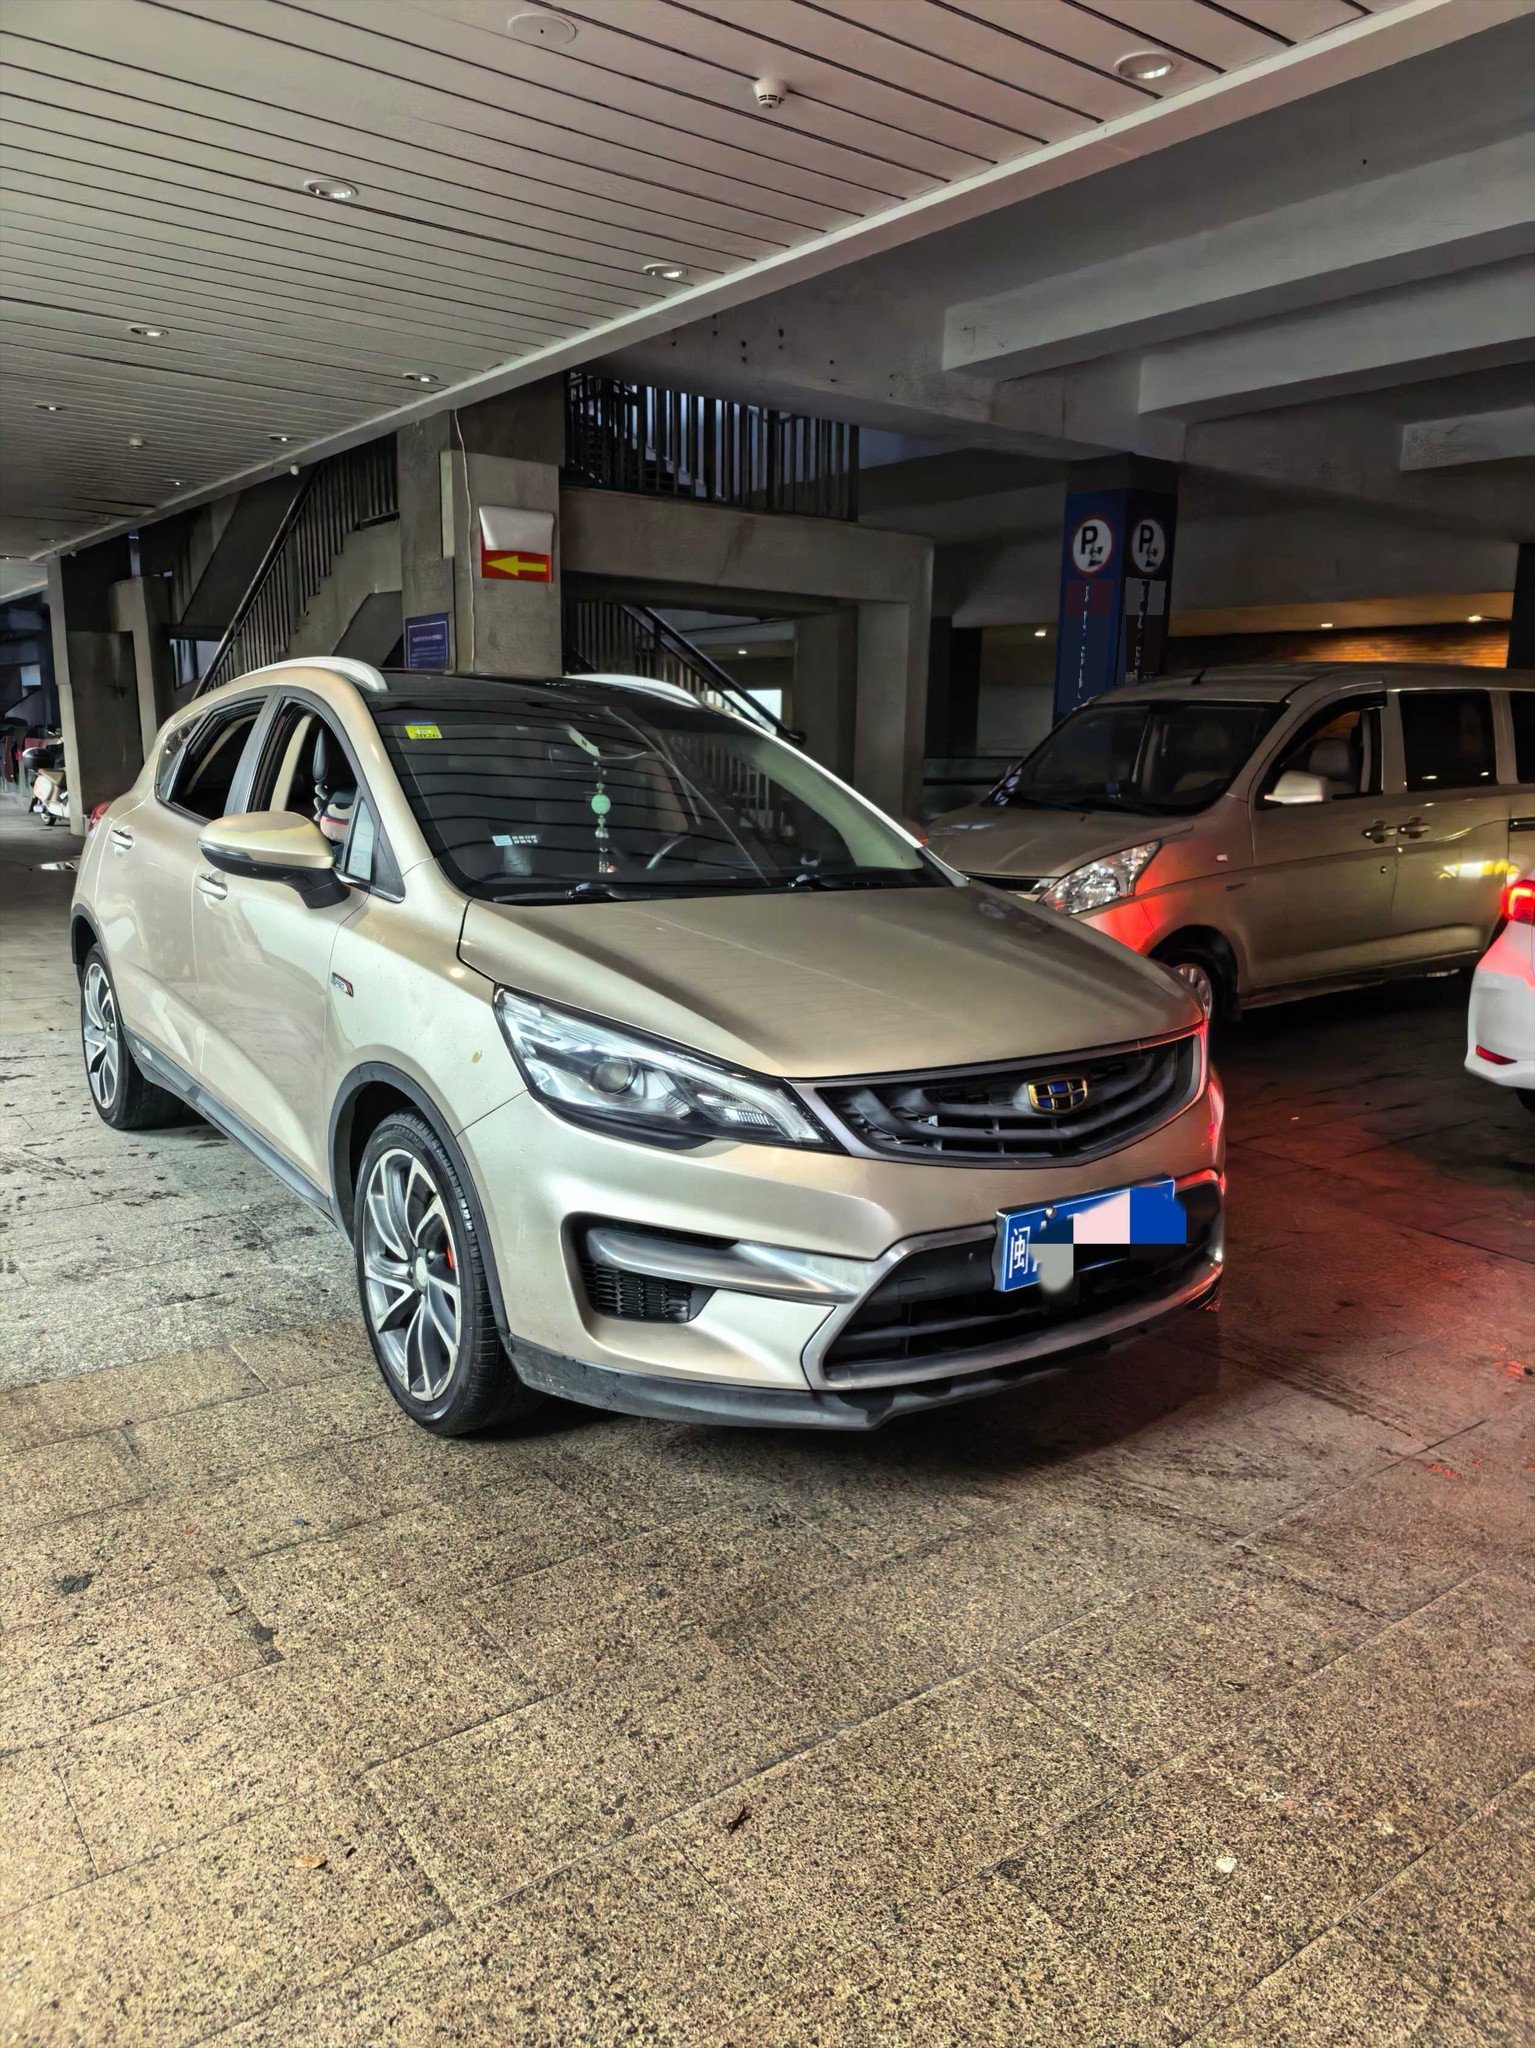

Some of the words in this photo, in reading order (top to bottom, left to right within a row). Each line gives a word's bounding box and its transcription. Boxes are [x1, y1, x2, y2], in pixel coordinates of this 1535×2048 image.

[1081, 525, 1098, 555] P
[1138, 524, 1154, 553] P
[1008, 1225, 1031, 1279] 闽
